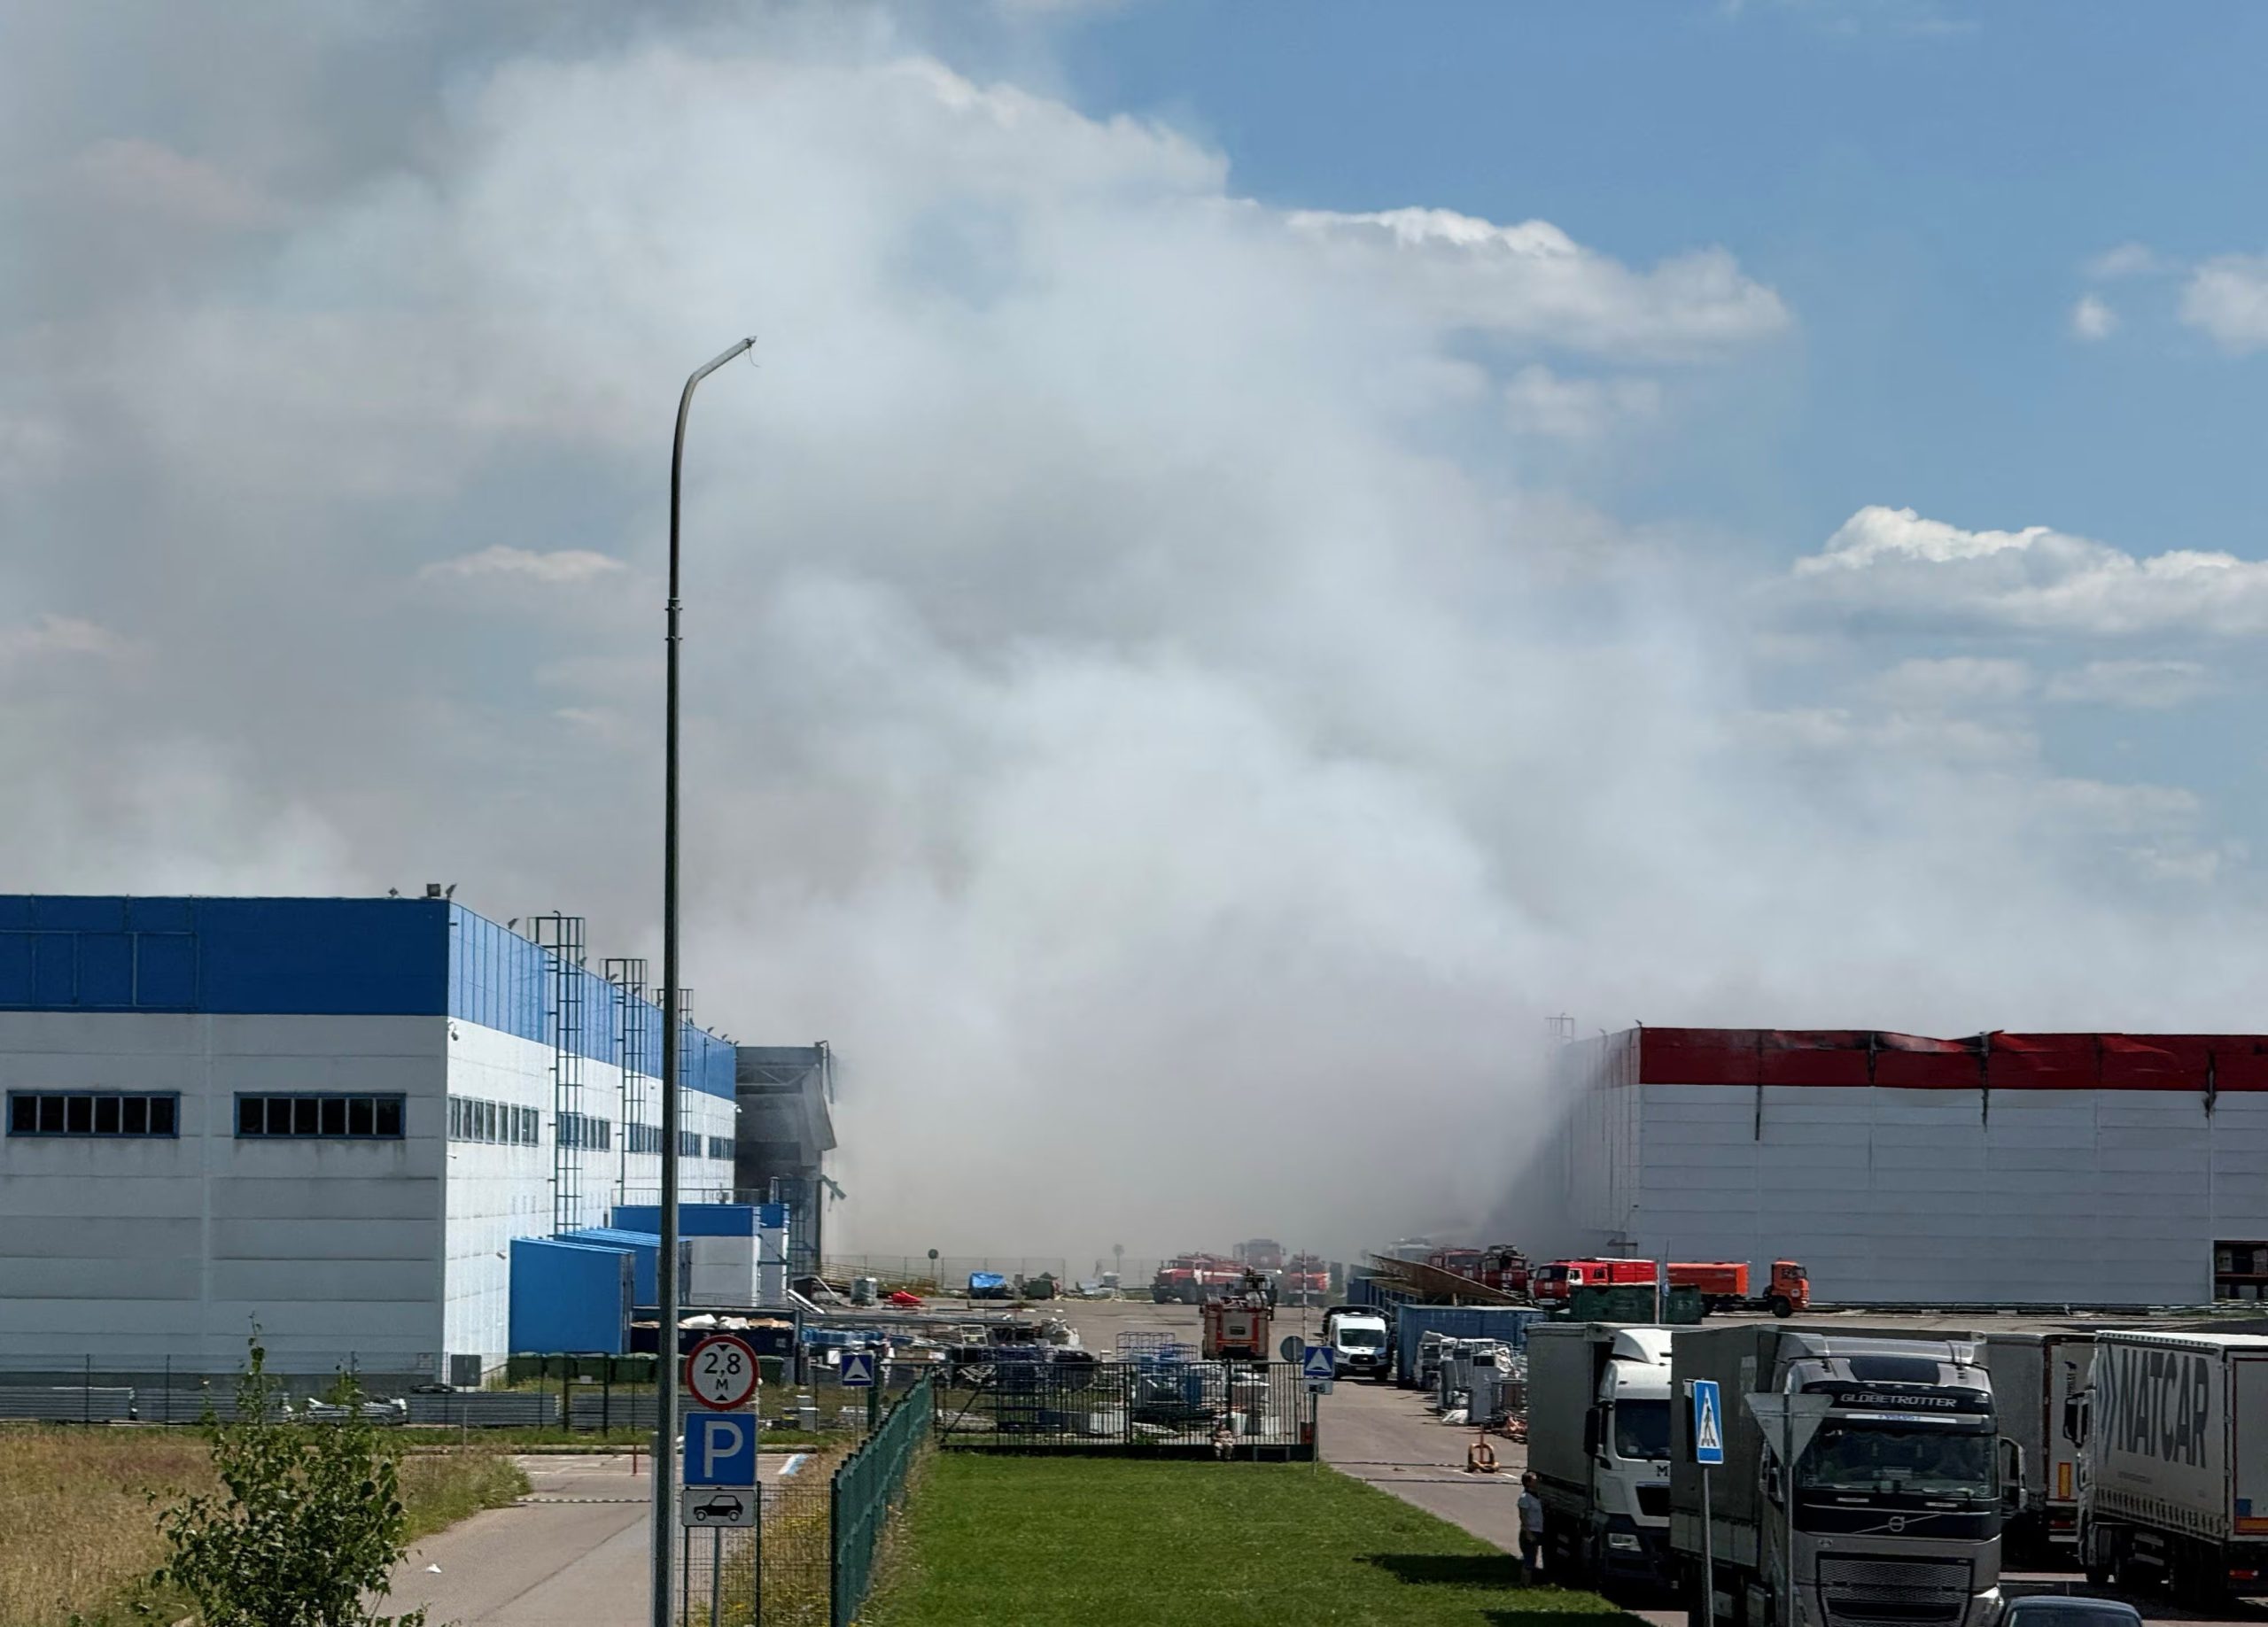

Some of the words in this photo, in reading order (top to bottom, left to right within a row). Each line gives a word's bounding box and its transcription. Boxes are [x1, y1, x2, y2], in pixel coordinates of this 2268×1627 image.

[704, 1352, 741, 1377] 2,8
[1840, 1393, 1957, 1407] GLOBETROTTER
[2117, 1347, 2210, 1469] NATCAR
[703, 1421, 743, 1477] P
